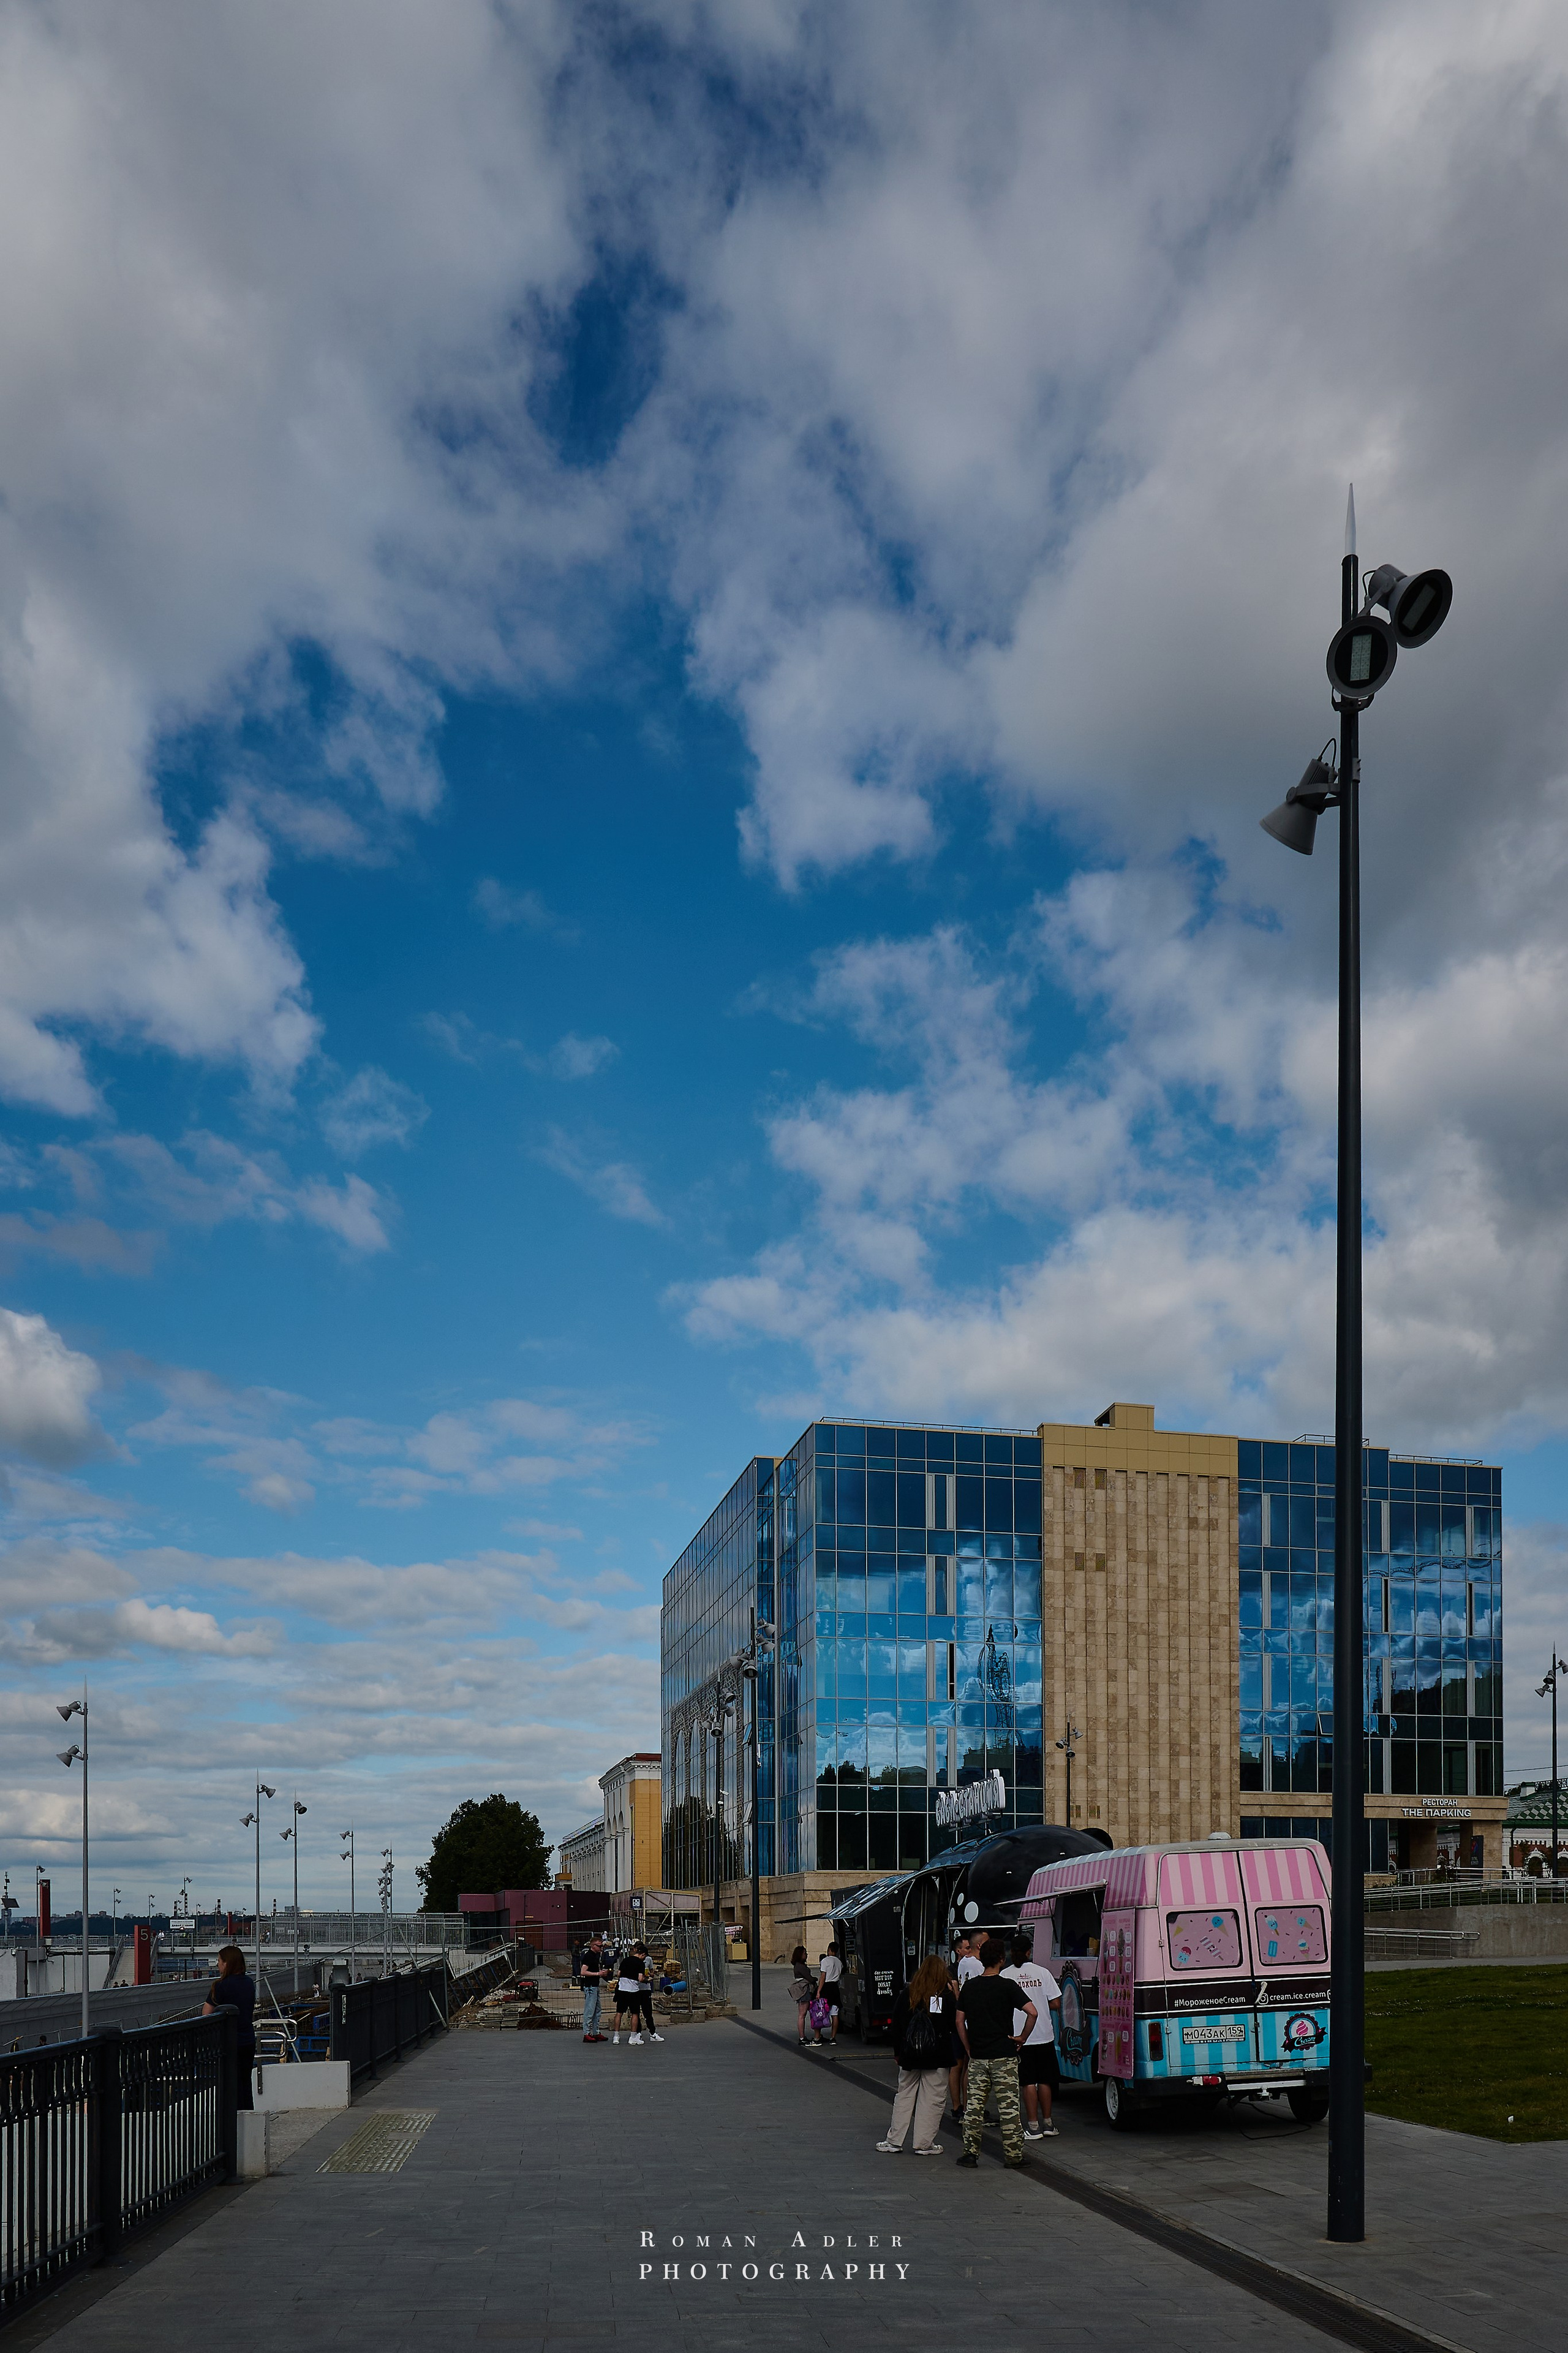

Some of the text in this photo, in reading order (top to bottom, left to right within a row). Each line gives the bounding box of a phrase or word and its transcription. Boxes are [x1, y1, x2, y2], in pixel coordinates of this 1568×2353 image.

[140, 1929, 148, 1940] 5
[1174, 1996, 1246, 2007] #МороженоеCream
[1270, 1992, 1326, 2001] cream.ice.cream
[1066, 2027, 1084, 2052] Cream
[1294, 2036, 1316, 2047] Cream
